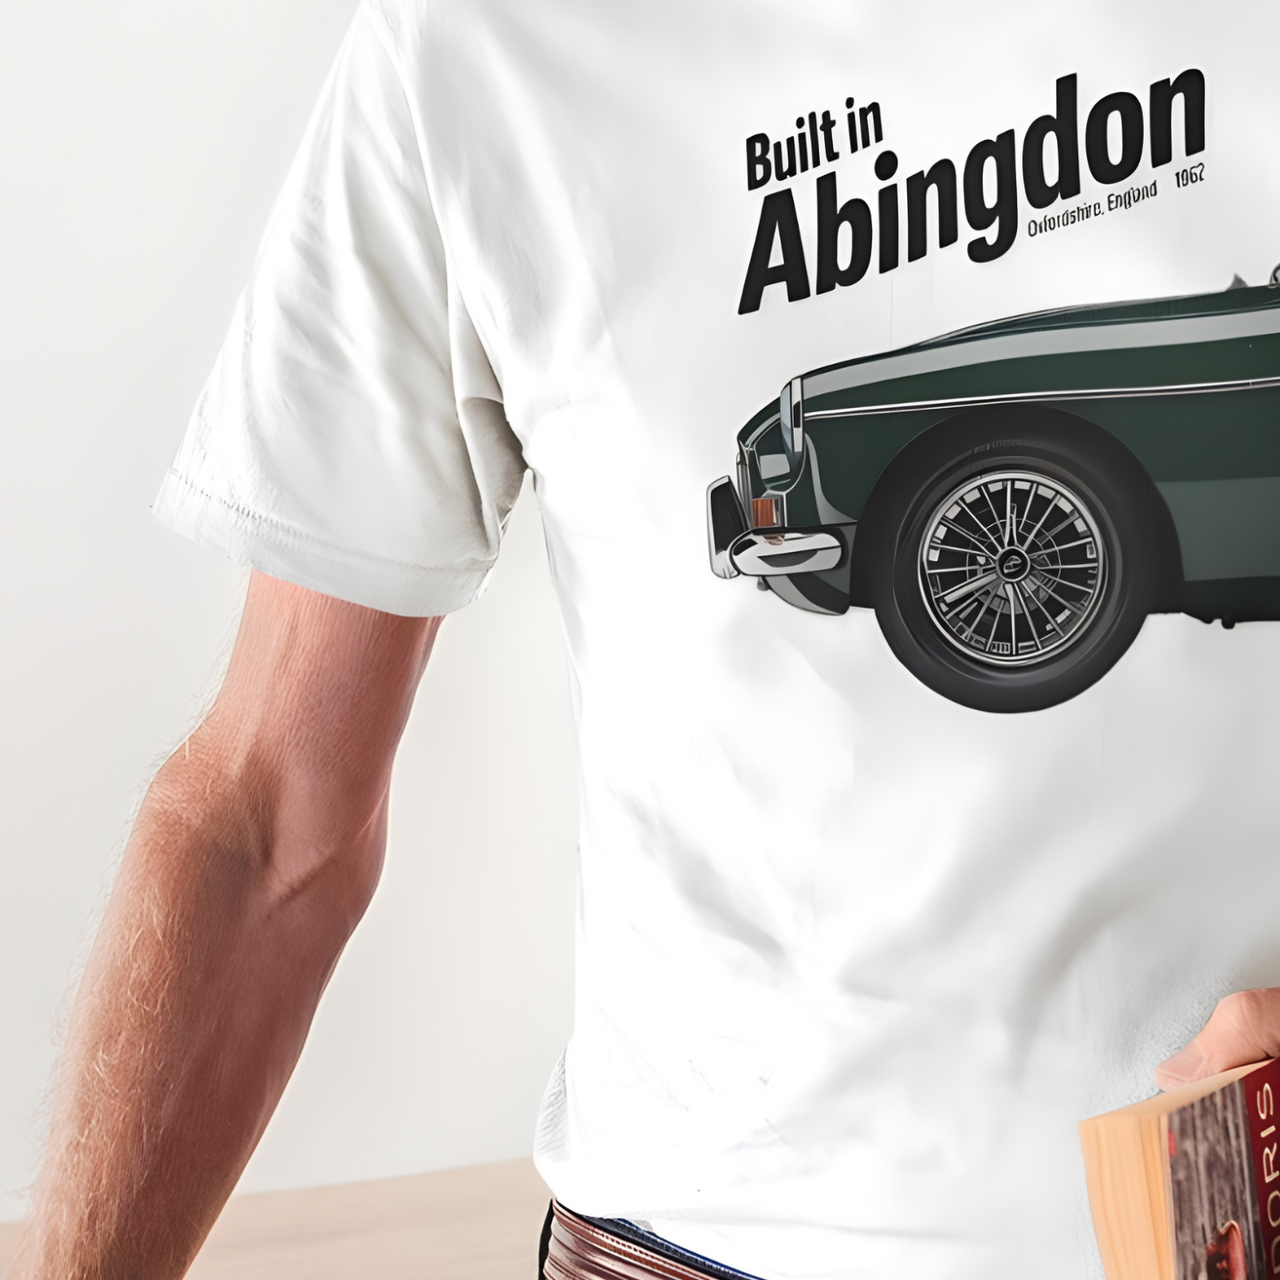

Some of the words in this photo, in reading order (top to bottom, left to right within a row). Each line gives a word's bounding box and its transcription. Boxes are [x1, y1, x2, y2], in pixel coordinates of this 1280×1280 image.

[738, 69, 1205, 315] Abingdon
[746, 110, 839, 191] Built
[846, 97, 883, 153] in
